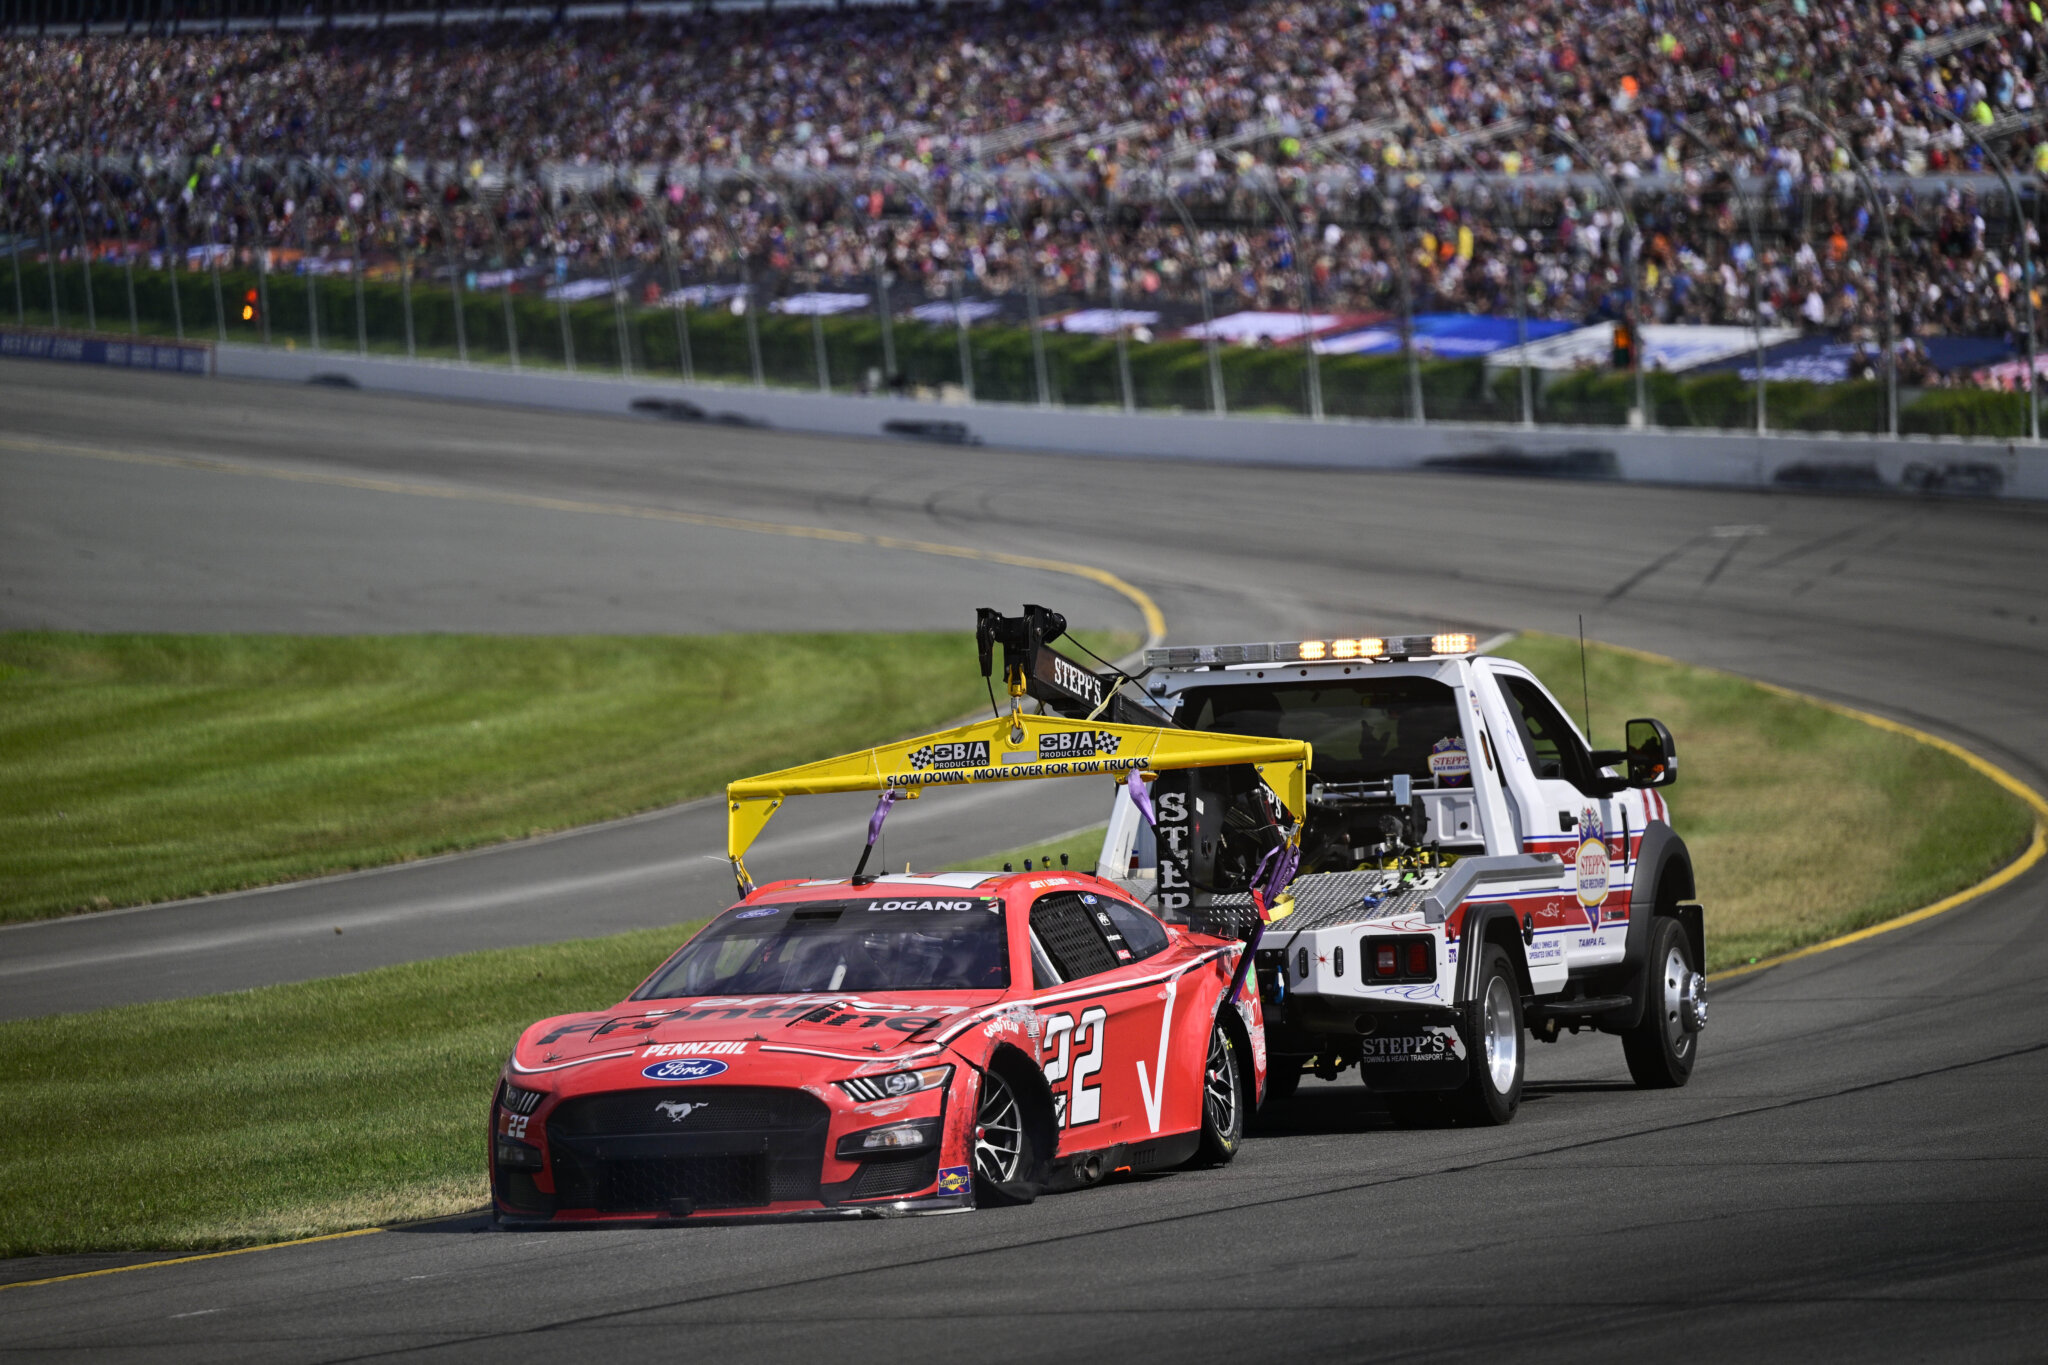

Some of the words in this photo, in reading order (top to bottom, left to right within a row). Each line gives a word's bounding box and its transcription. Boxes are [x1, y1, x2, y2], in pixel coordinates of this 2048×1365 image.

[1054, 657, 1102, 707] STEPP'S
[1059, 731, 1094, 750] B/A
[953, 742, 988, 761] B/A
[1039, 749, 1081, 759] PRODUCTS
[887, 774, 922, 787] SLOW
[923, 770, 964, 784] DOWN
[973, 767, 1009, 781] MOVE
[1010, 765, 1044, 779] OVER
[1045, 763, 1070, 776] FOR
[1071, 761, 1100, 774] TOW
[1102, 757, 1149, 771] TRUCKS
[934, 760, 975, 770] PRODUCTS
[868, 901, 973, 912] LOGANO
[1578, 938, 1597, 948] TAMPA
[641, 1041, 747, 1058] PENNZOIL
[1363, 1035, 1445, 1056] STEPP'S
[1391, 1054, 1410, 1062] HEAVY
[1410, 1053, 1444, 1061] TRANSPORT
[656, 1060, 711, 1078] Ford
[1042, 1005, 1107, 1130] 22
[508, 1114, 530, 1138] 22
[942, 1177, 967, 1187] SUNOCO
